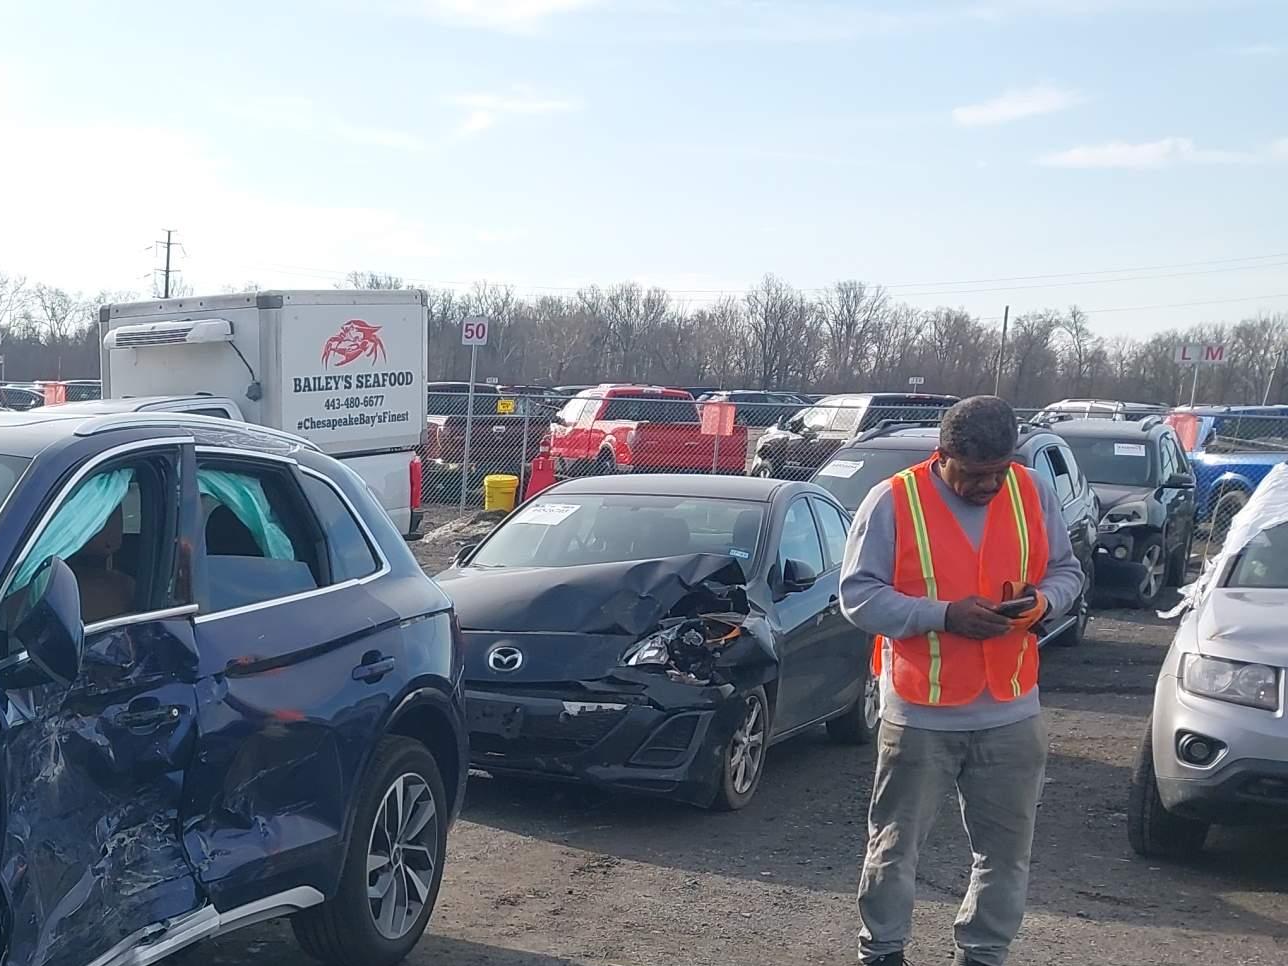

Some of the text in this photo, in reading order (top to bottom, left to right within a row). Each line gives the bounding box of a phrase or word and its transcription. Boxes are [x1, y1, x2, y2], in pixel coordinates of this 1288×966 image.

[464, 322, 486, 340] 50
[1181, 345, 1224, 361] L M
[293, 371, 414, 393] BAILEY'S SEAFOOD
[324, 395, 385, 410] 443-480-6677
[297, 410, 410, 431] #ChesapeakeBay'sFinest
